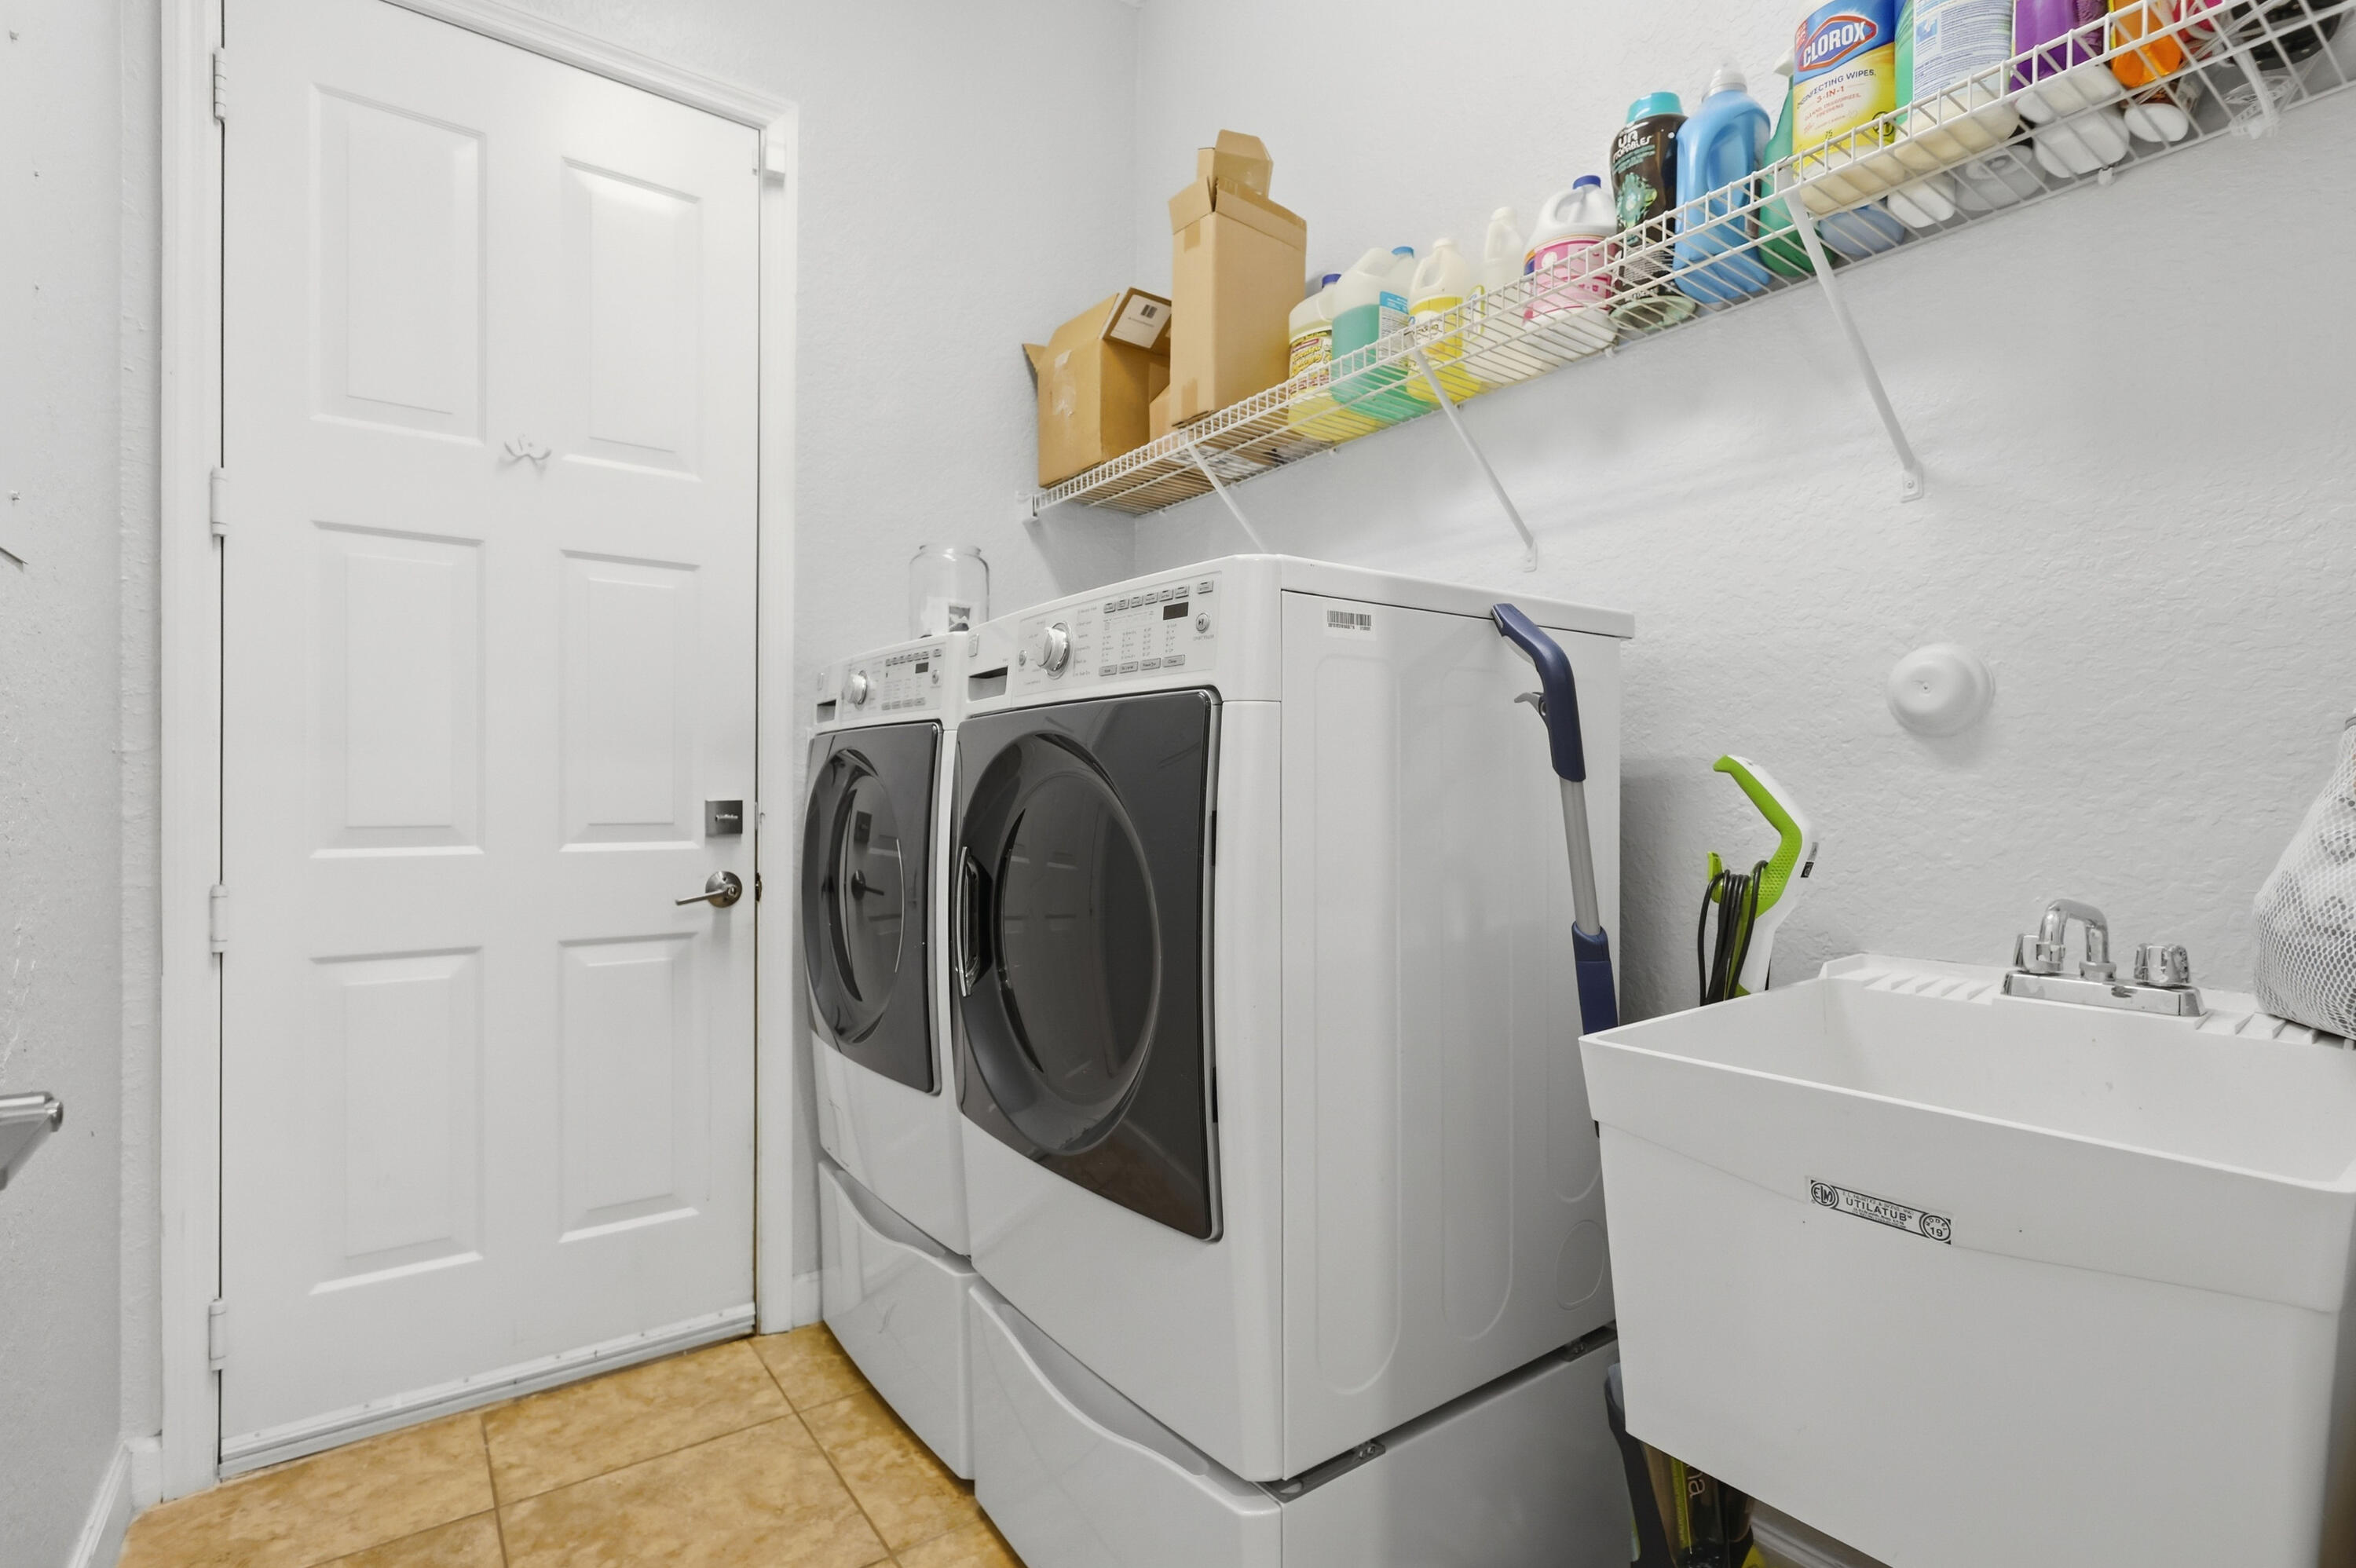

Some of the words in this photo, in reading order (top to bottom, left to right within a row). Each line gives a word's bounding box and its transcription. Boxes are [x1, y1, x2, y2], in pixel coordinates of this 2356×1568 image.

[1803, 20, 1865, 68] CLOROX
[1816, 86, 1845, 103] 3-IN-1
[1930, 1227, 1943, 1237] 19
